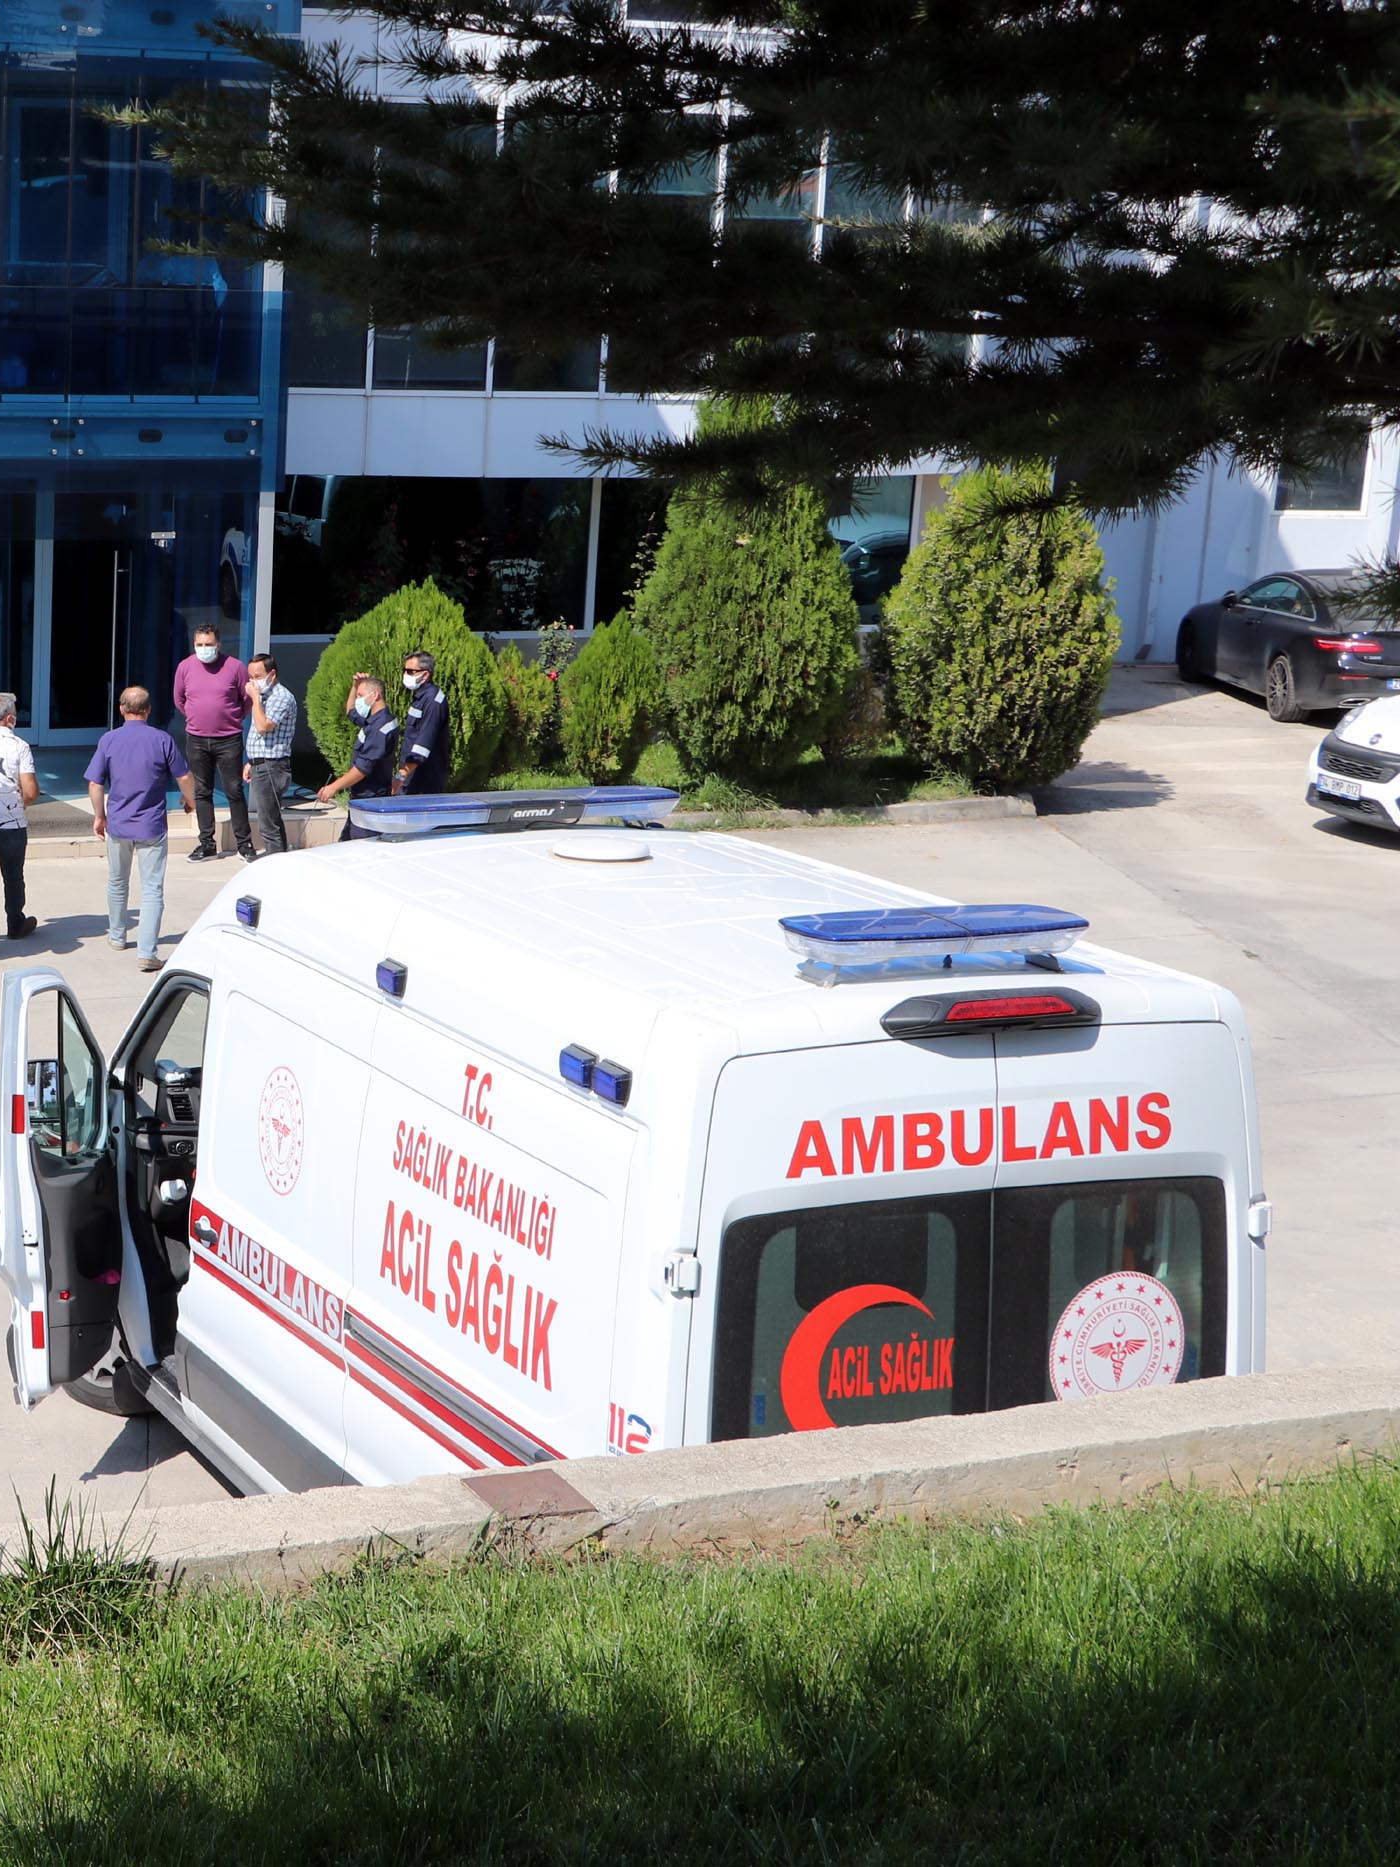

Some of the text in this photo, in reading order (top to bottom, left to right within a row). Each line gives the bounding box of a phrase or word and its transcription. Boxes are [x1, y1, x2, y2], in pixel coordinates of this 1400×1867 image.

[462, 1063, 493, 1130] T.C.
[785, 1091, 1173, 1179] AMBULANS
[393, 1119, 453, 1200] SAĞLIK
[453, 1154, 557, 1261] BAKANLIĞI
[216, 1220, 341, 1340] AMBULANS
[445, 1239, 558, 1392] SAĞLIK
[879, 1331, 955, 1396] SAĞLIK
